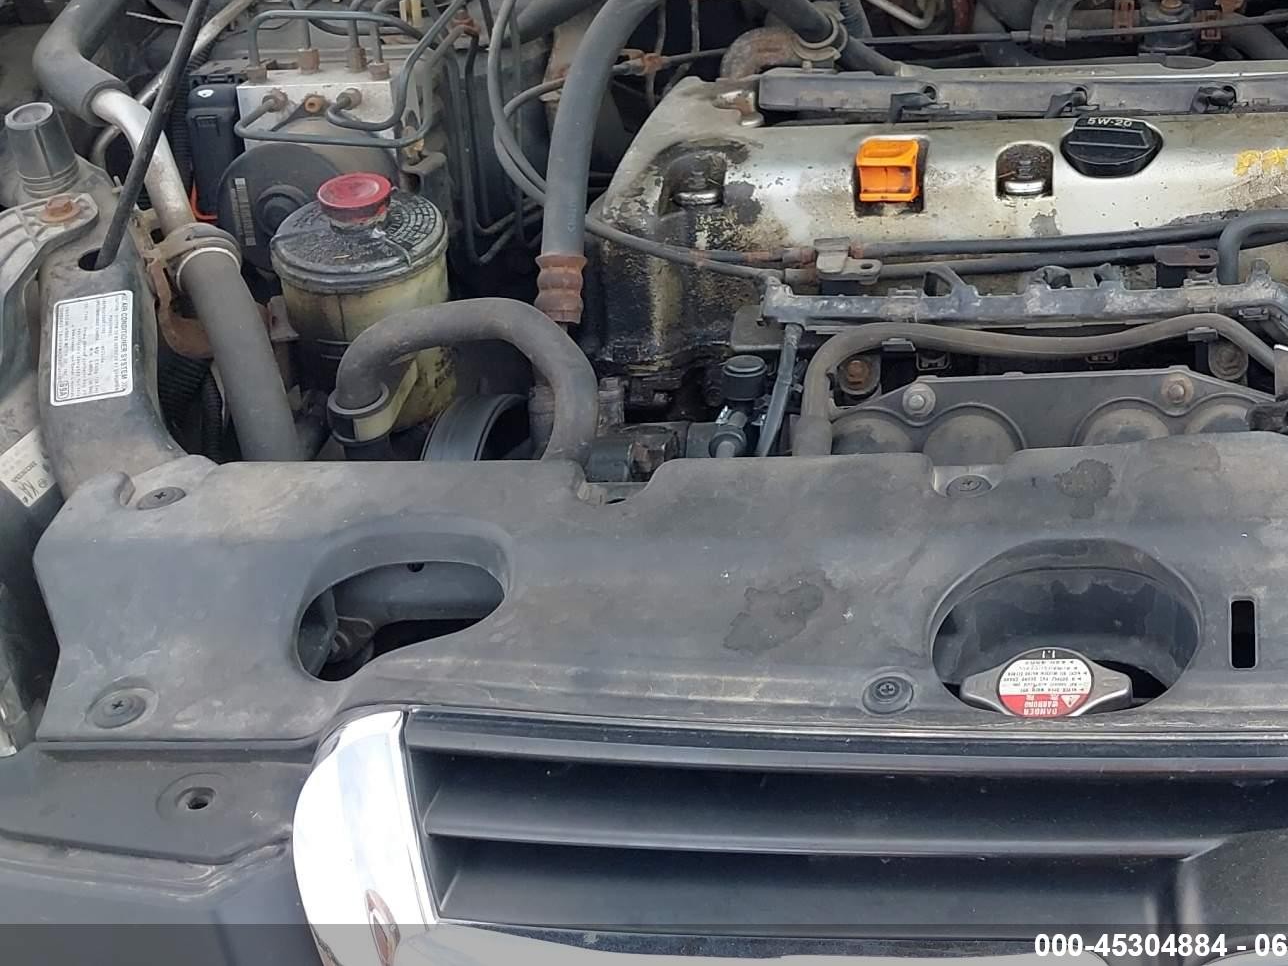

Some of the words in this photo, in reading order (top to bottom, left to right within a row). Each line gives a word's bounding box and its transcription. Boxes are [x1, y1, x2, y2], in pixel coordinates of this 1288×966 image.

[1087, 117, 1132, 127] 5W-20
[120, 313, 128, 352] CONDITIONER
[120, 354, 128, 380] SYSTEM
